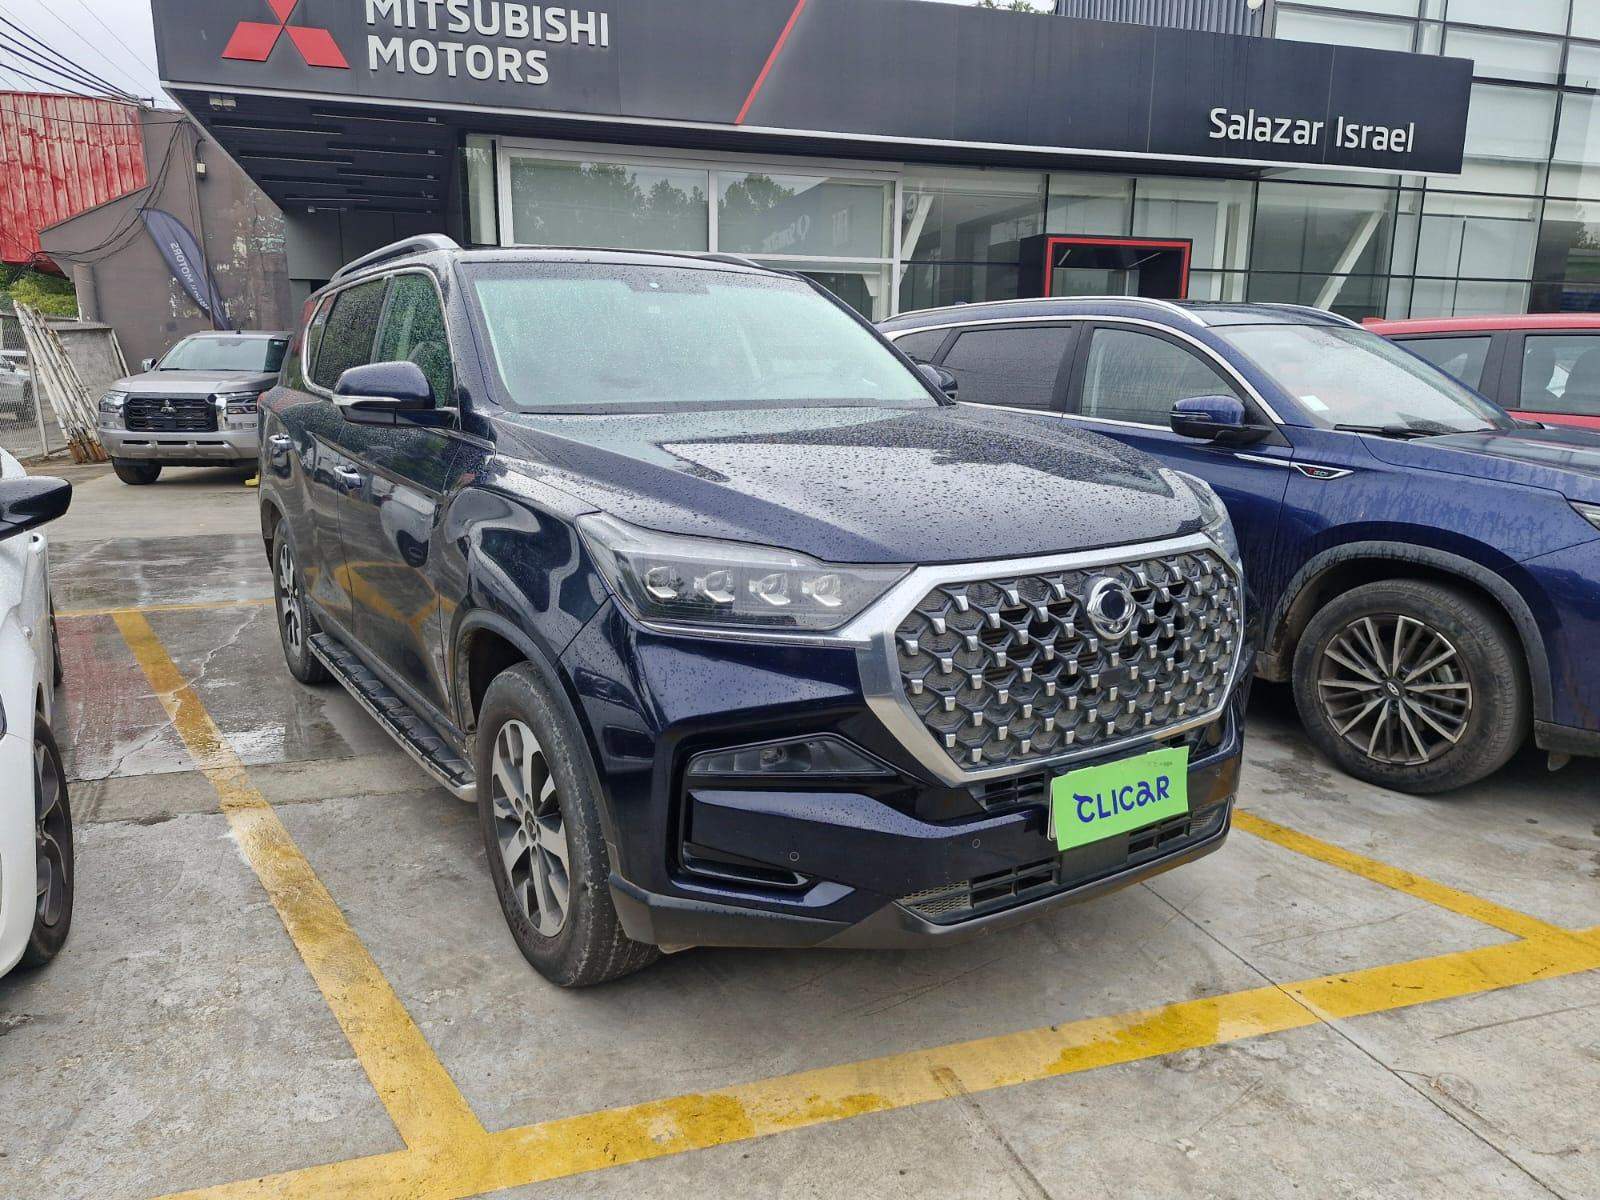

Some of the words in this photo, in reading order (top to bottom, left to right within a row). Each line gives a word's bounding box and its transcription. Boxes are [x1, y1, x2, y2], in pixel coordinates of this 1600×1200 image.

[365, 0, 609, 47] MITSUBISHI
[367, 35, 549, 85] MOTORS
[1209, 107, 1324, 145] Salazar
[1335, 116, 1415, 153] Israel
